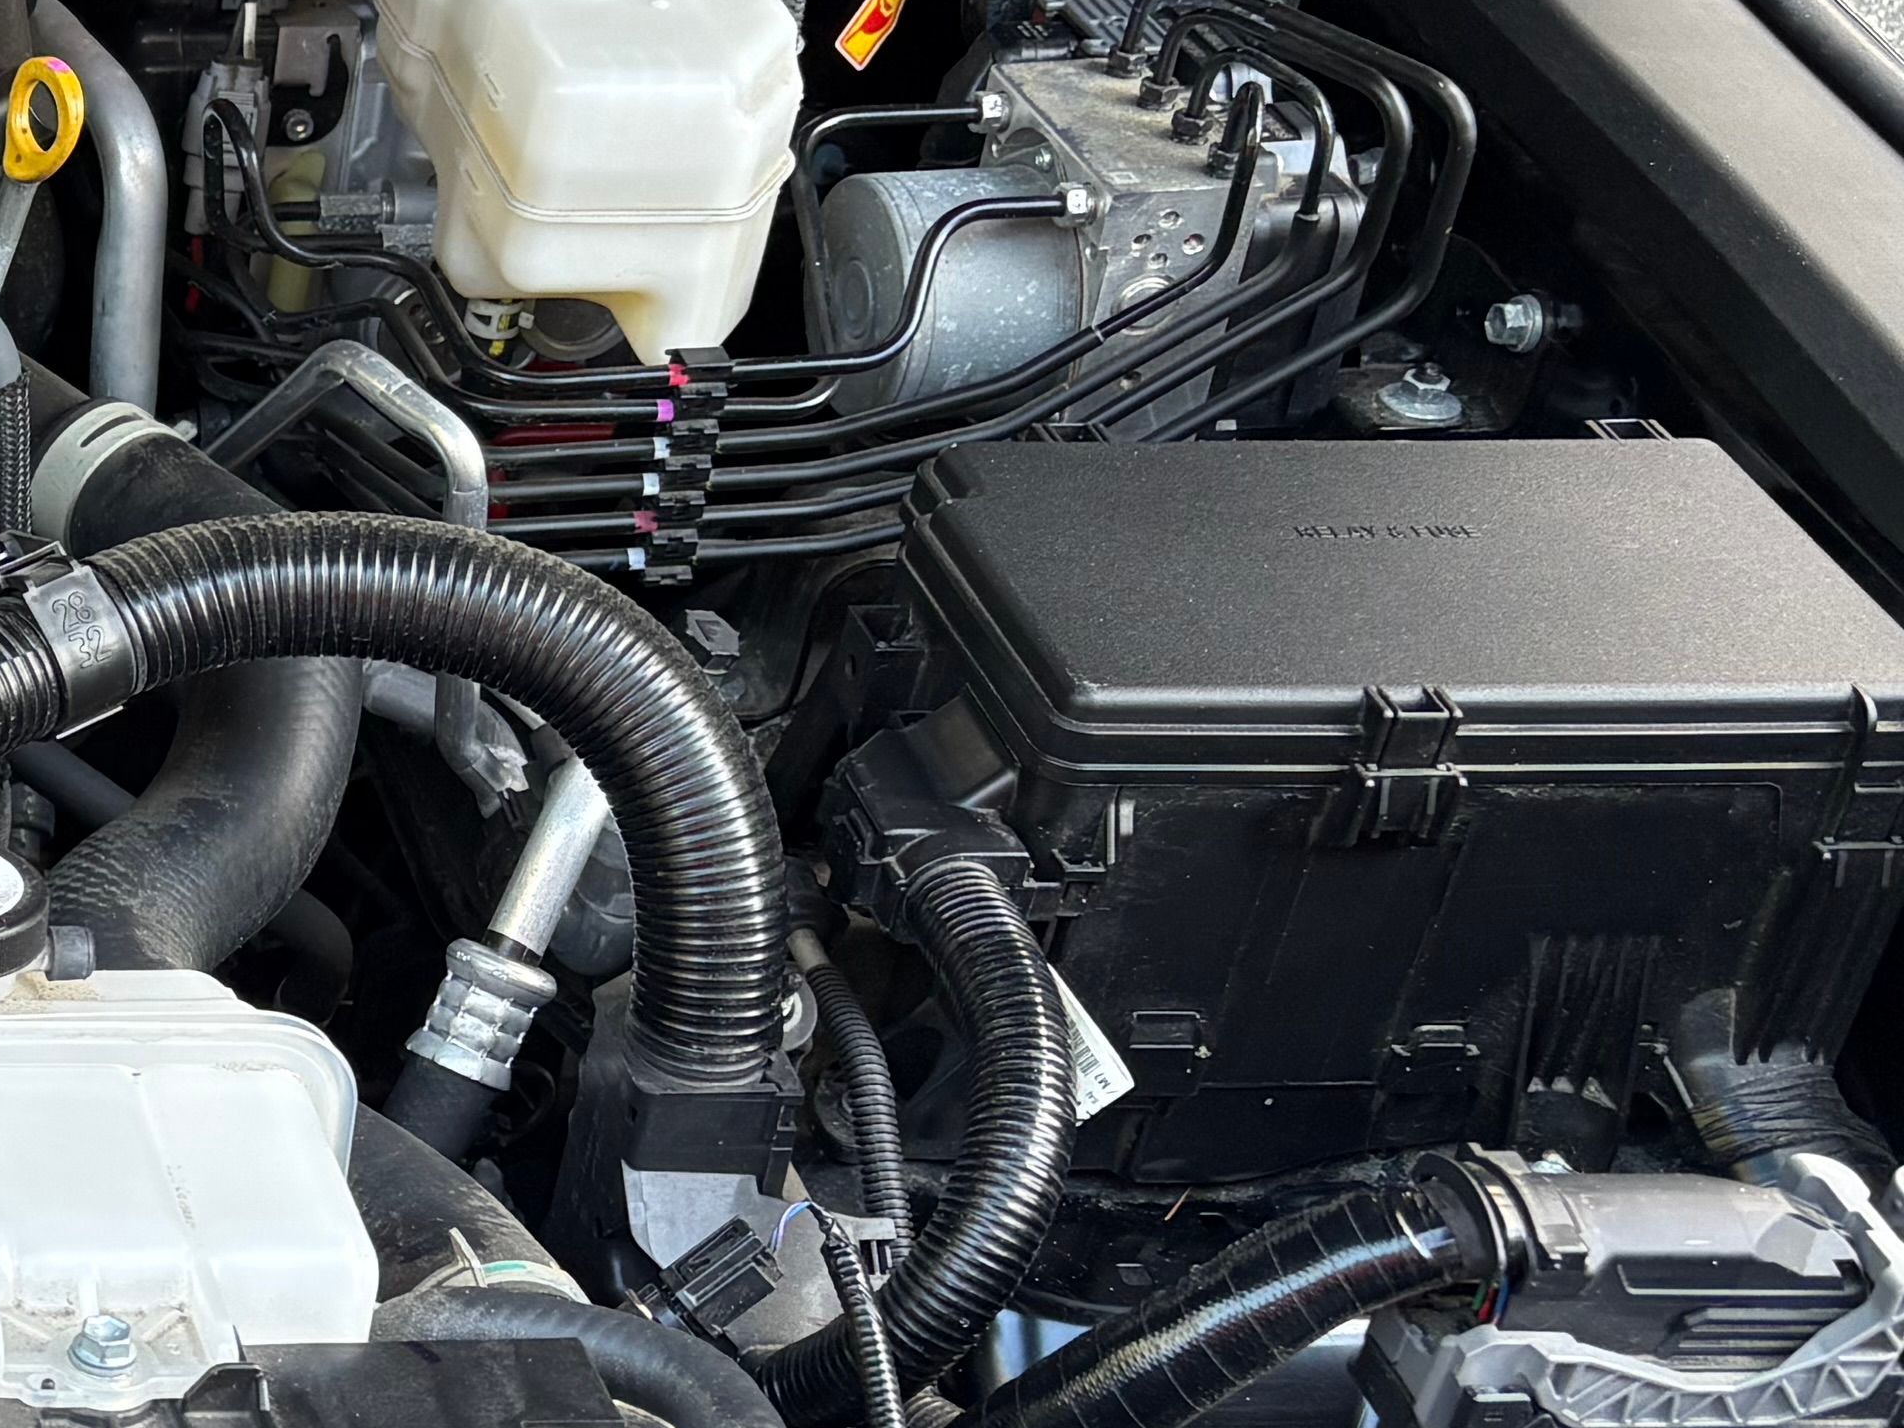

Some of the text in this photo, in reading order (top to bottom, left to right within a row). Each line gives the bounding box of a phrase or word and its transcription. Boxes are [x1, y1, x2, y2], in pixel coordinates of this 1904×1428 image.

[1293, 525, 1483, 539] RELAY & FUSE
[51, 590, 97, 635] 28
[67, 624, 114, 670] 32
